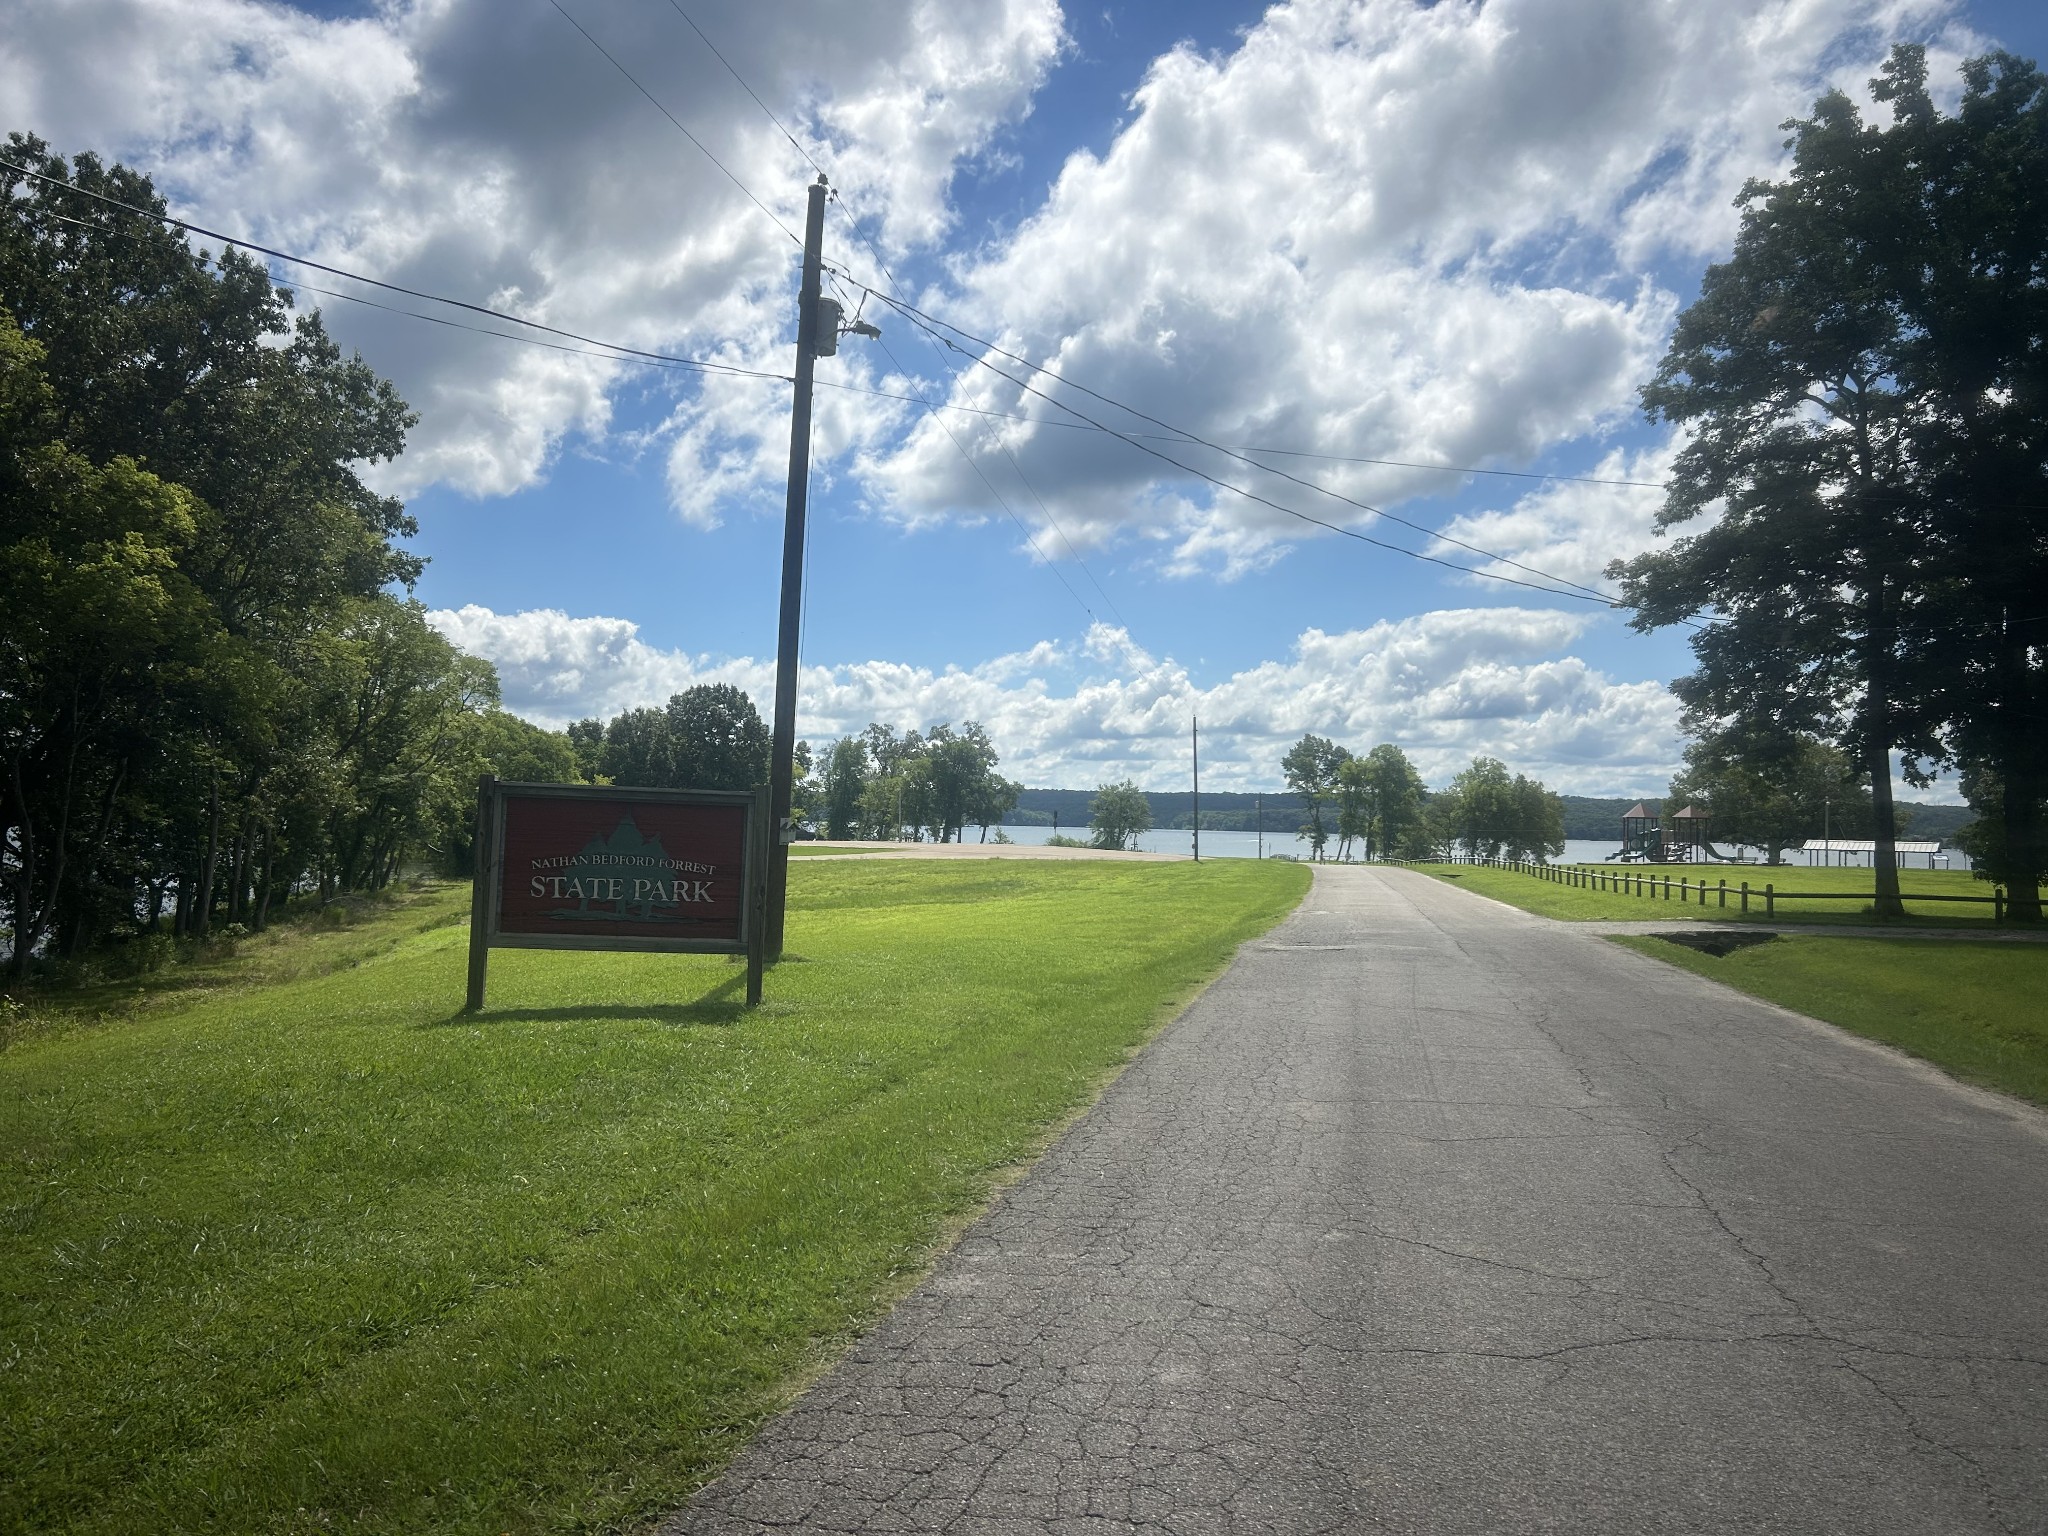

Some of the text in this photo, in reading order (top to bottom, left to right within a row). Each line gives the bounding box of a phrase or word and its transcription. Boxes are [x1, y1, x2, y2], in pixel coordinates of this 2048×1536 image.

[531, 854, 717, 875] NATHAN BEDFORD FORREST
[530, 875, 715, 903] STATE PARK
